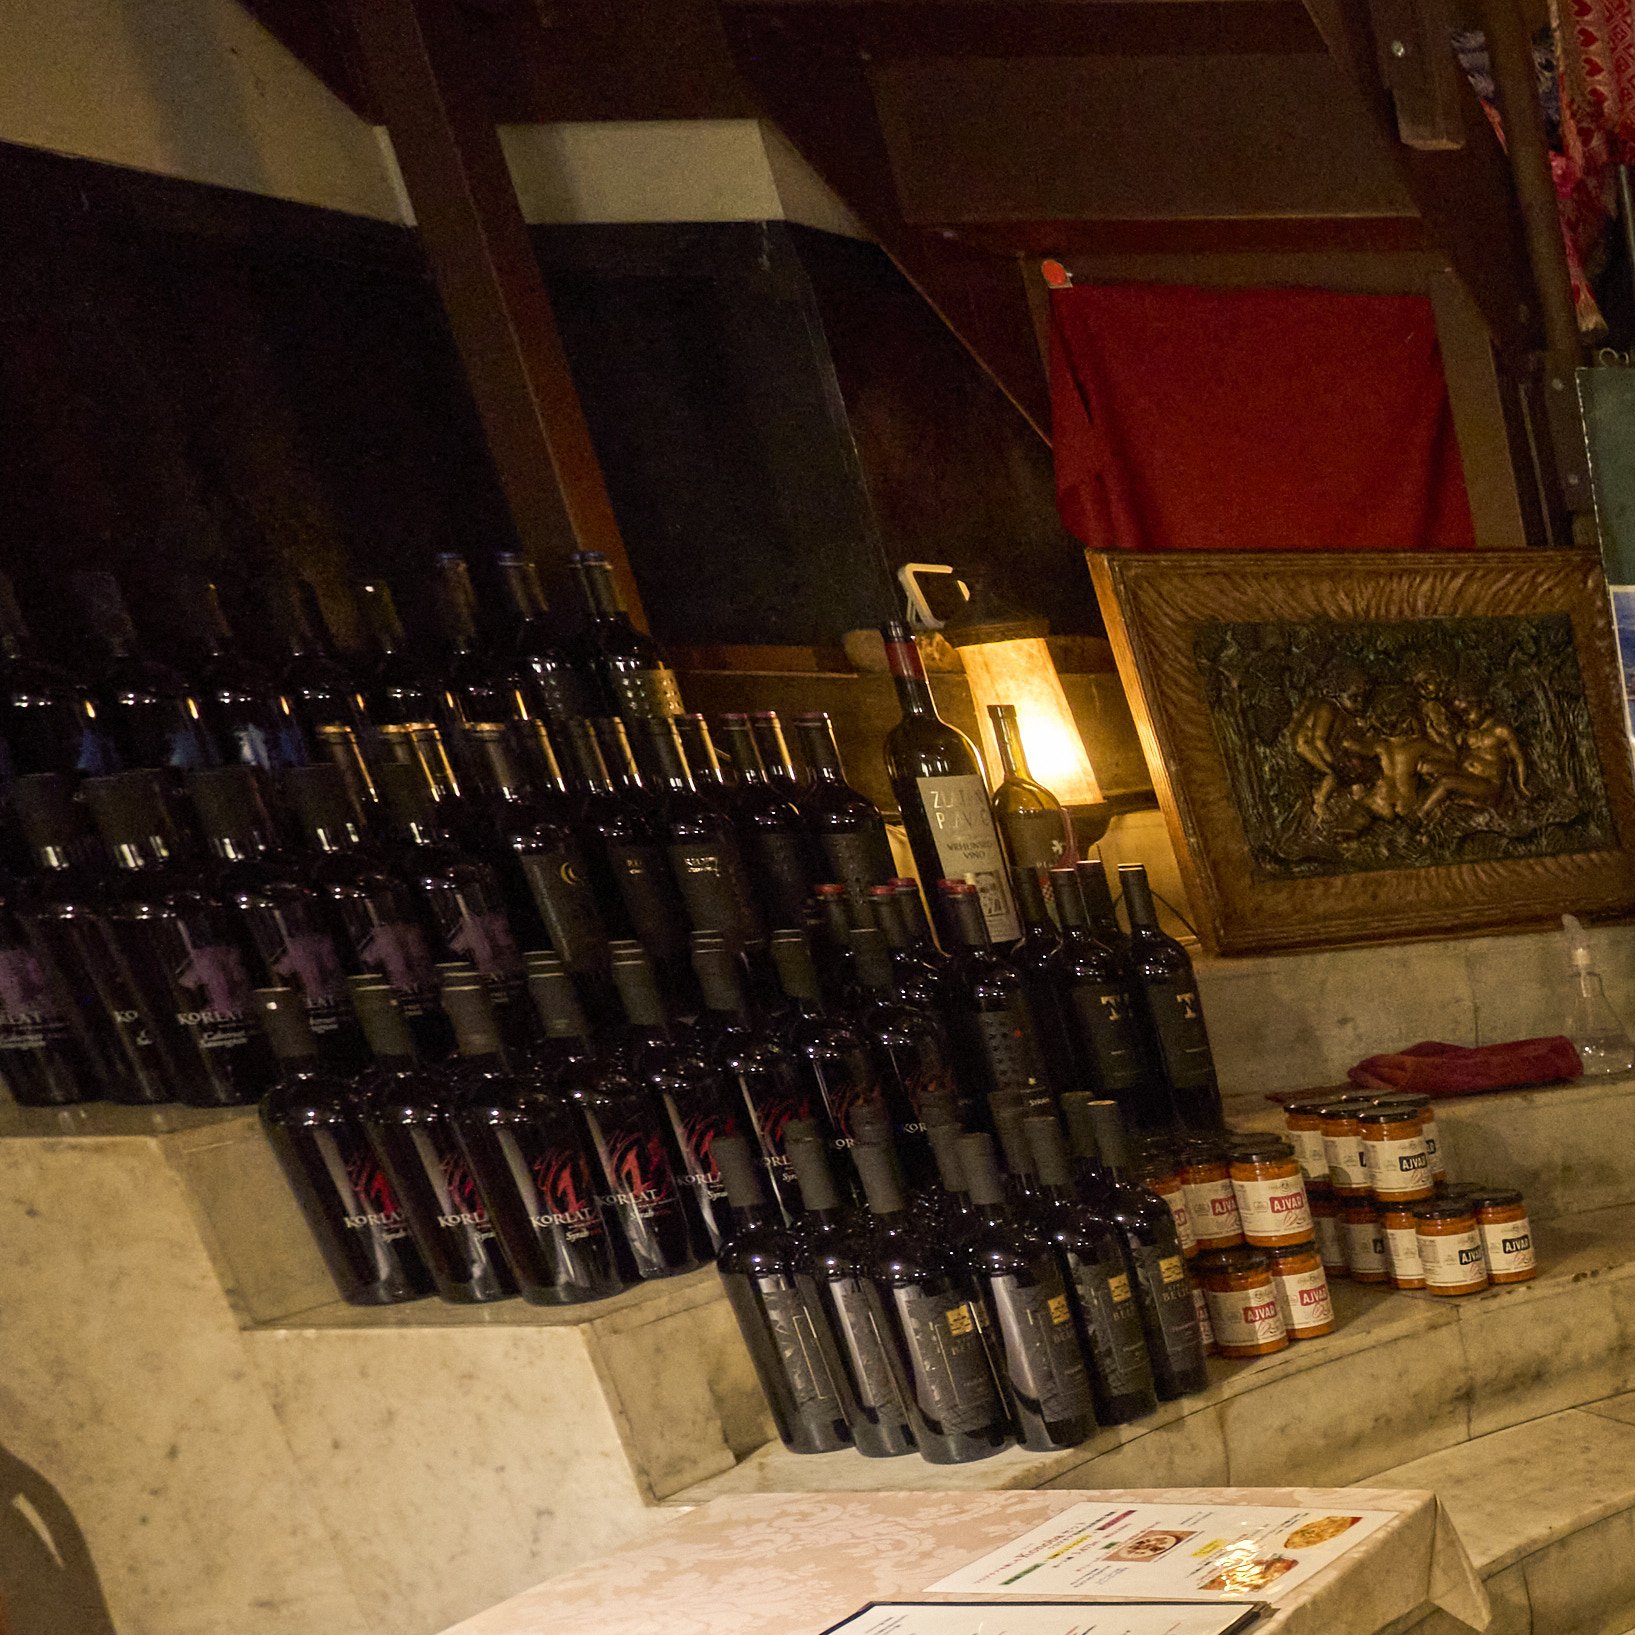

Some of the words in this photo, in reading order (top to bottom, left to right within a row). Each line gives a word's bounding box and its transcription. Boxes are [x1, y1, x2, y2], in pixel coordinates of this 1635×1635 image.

[1273, 1194, 1303, 1212] AJVAR
[530, 1207, 594, 1229] KORLAT
[1504, 1237, 1530, 1252] AJVAR
[1303, 1287, 1328, 1305] AJVAR
[1249, 1304, 1276, 1321] AJVAR
